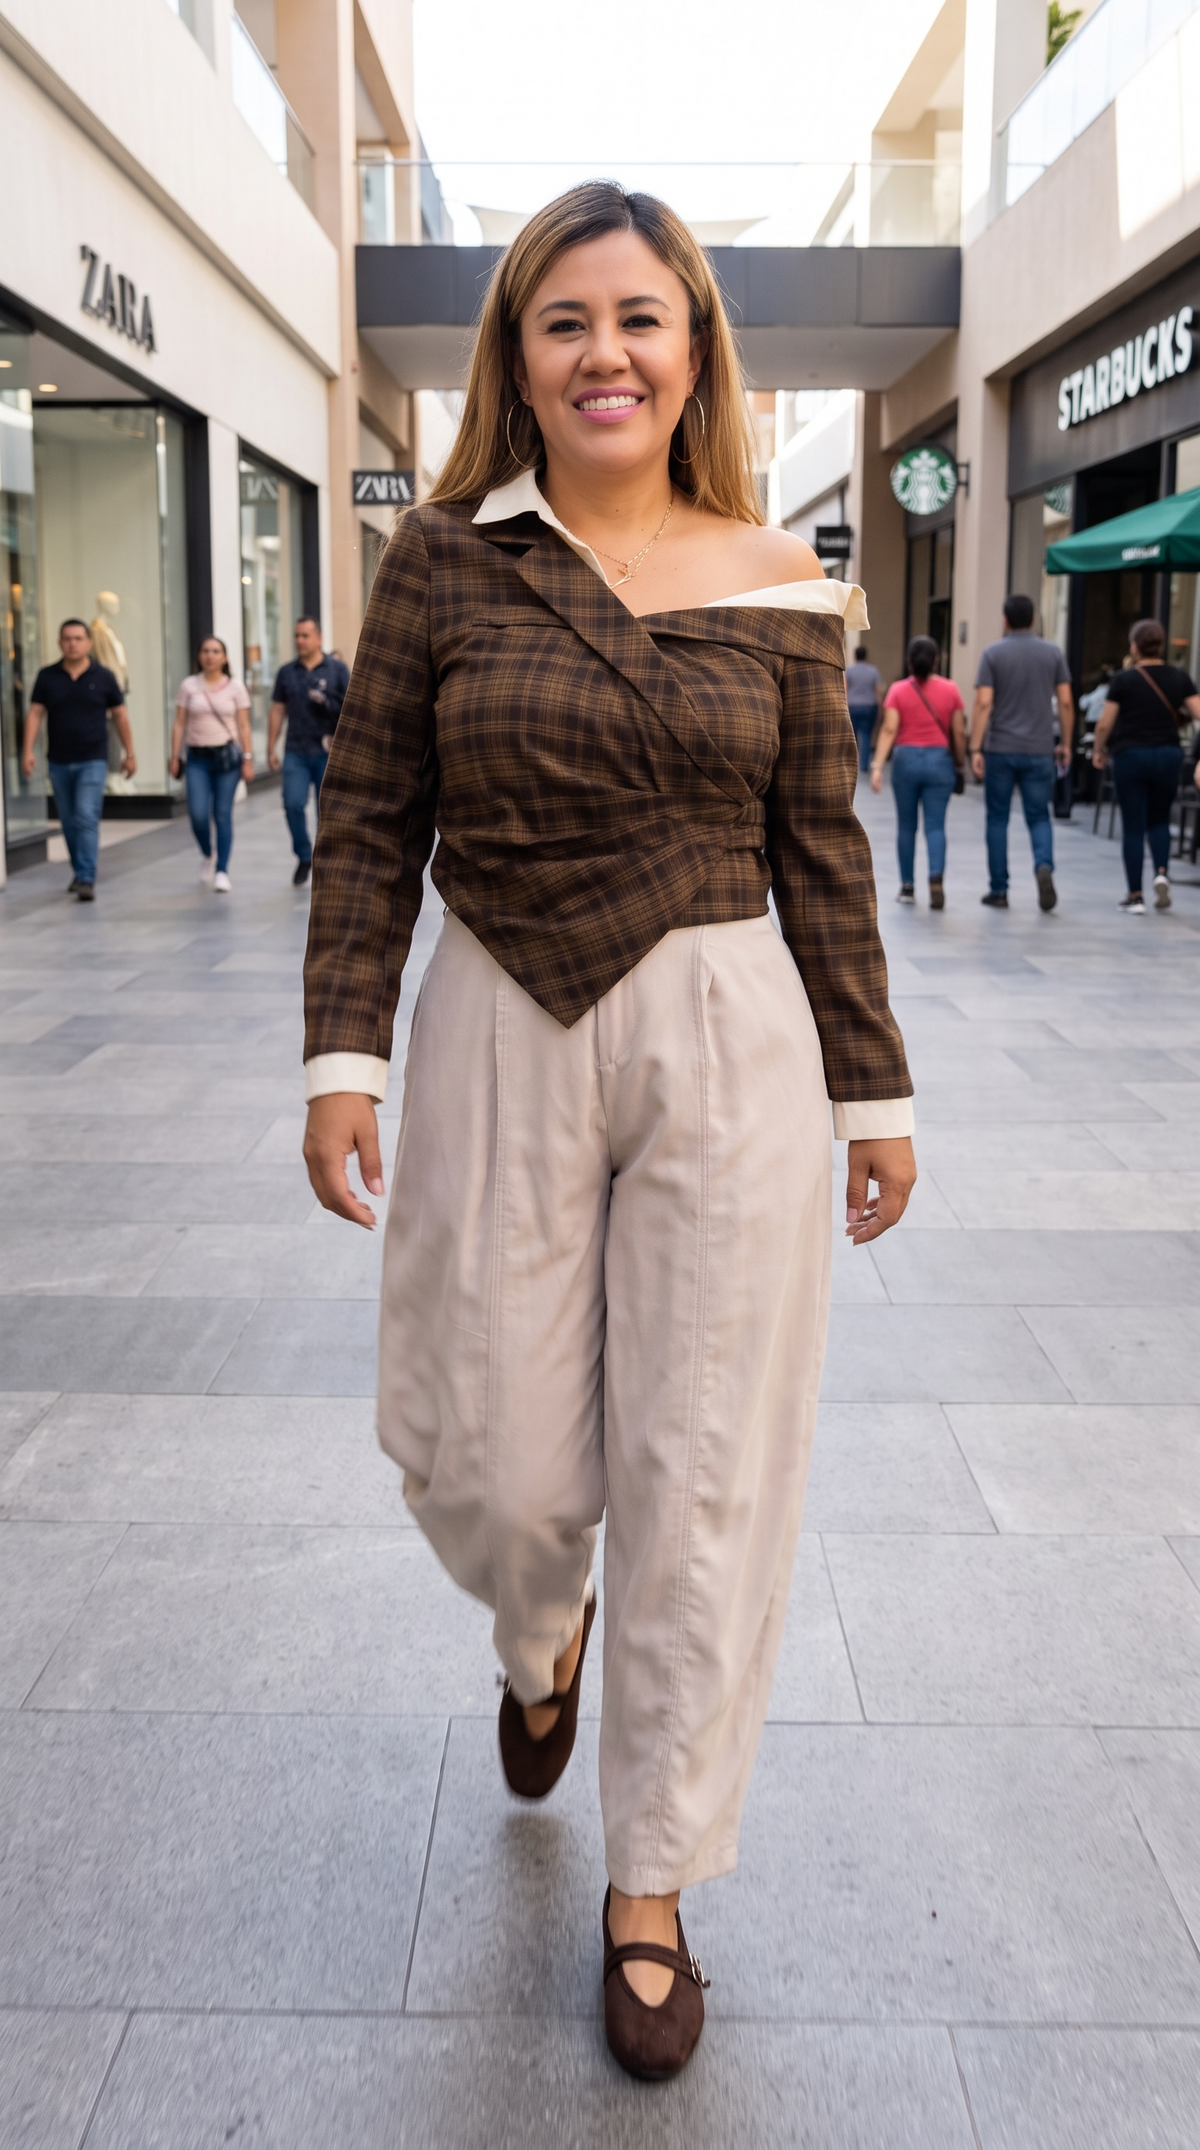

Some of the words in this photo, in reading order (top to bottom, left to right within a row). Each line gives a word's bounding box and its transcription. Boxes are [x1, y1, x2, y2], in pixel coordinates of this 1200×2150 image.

[79, 245, 157, 353] ZARA
[1058, 305, 1193, 431] STARBUCKS
[355, 474, 412, 500] ZARA
